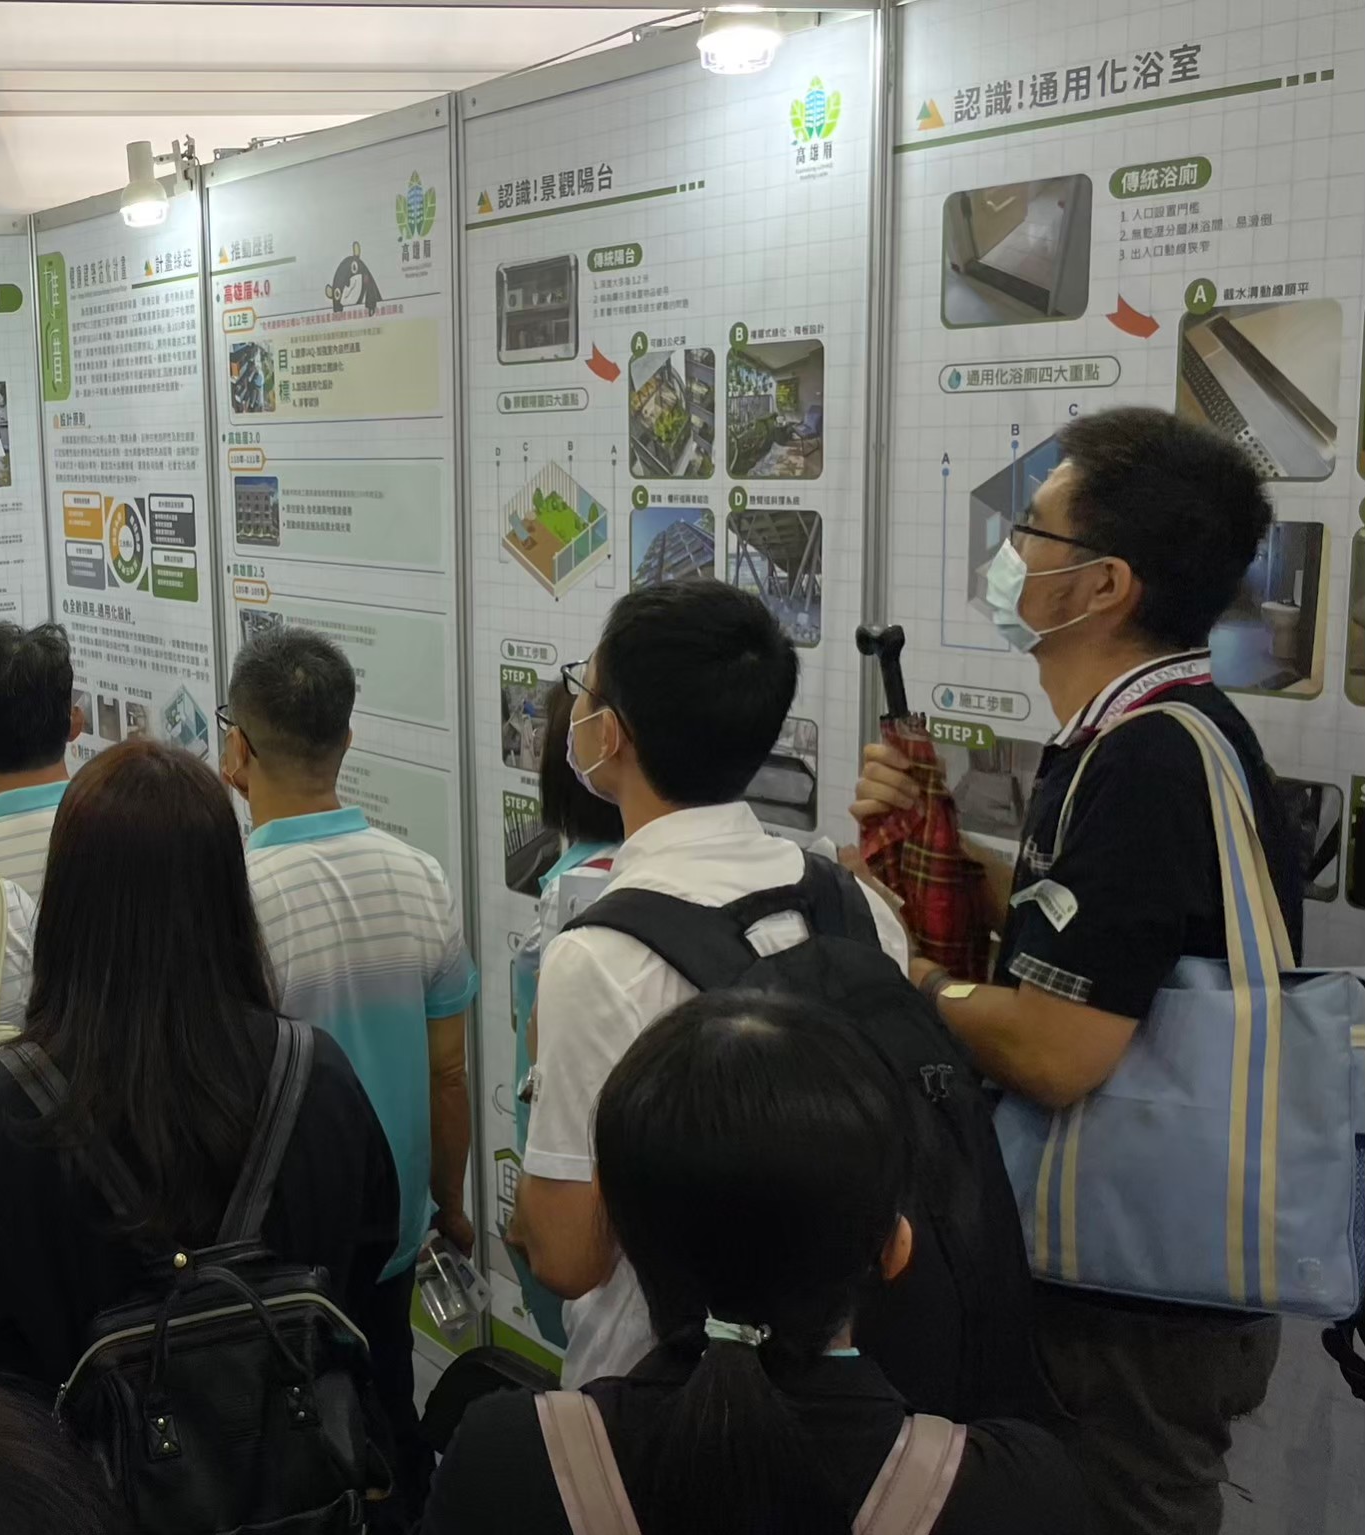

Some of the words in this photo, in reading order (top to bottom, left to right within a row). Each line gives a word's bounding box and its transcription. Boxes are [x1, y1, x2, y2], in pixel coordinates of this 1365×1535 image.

[953, 43, 1202, 123] 認識!通用化浴室
[1121, 163, 1198, 193] 傳統浴廁
[497, 162, 613, 210] 認識!景觀陽台
[1193, 284, 1207, 304] A
[735, 327, 744, 342] B
[635, 336, 644, 350] A
[966, 364, 1100, 387] 通用化浴廁四大重點
[1069, 404, 1078, 417] C
[1010, 423, 1020, 436] B
[495, 447, 501, 456] D
[522, 442, 529, 452] C
[567, 441, 574, 451] B
[611, 445, 617, 455] A
[941, 453, 951, 465] A
[637, 491, 644, 504] C
[735, 492, 743, 506] D
[502, 668, 525, 683] STEP
[526, 672, 532, 684] 1
[933, 723, 972, 742] STEP
[976, 729, 985, 745] 1
[505, 795, 528, 810] STEP
[528, 801, 535, 813] 4
